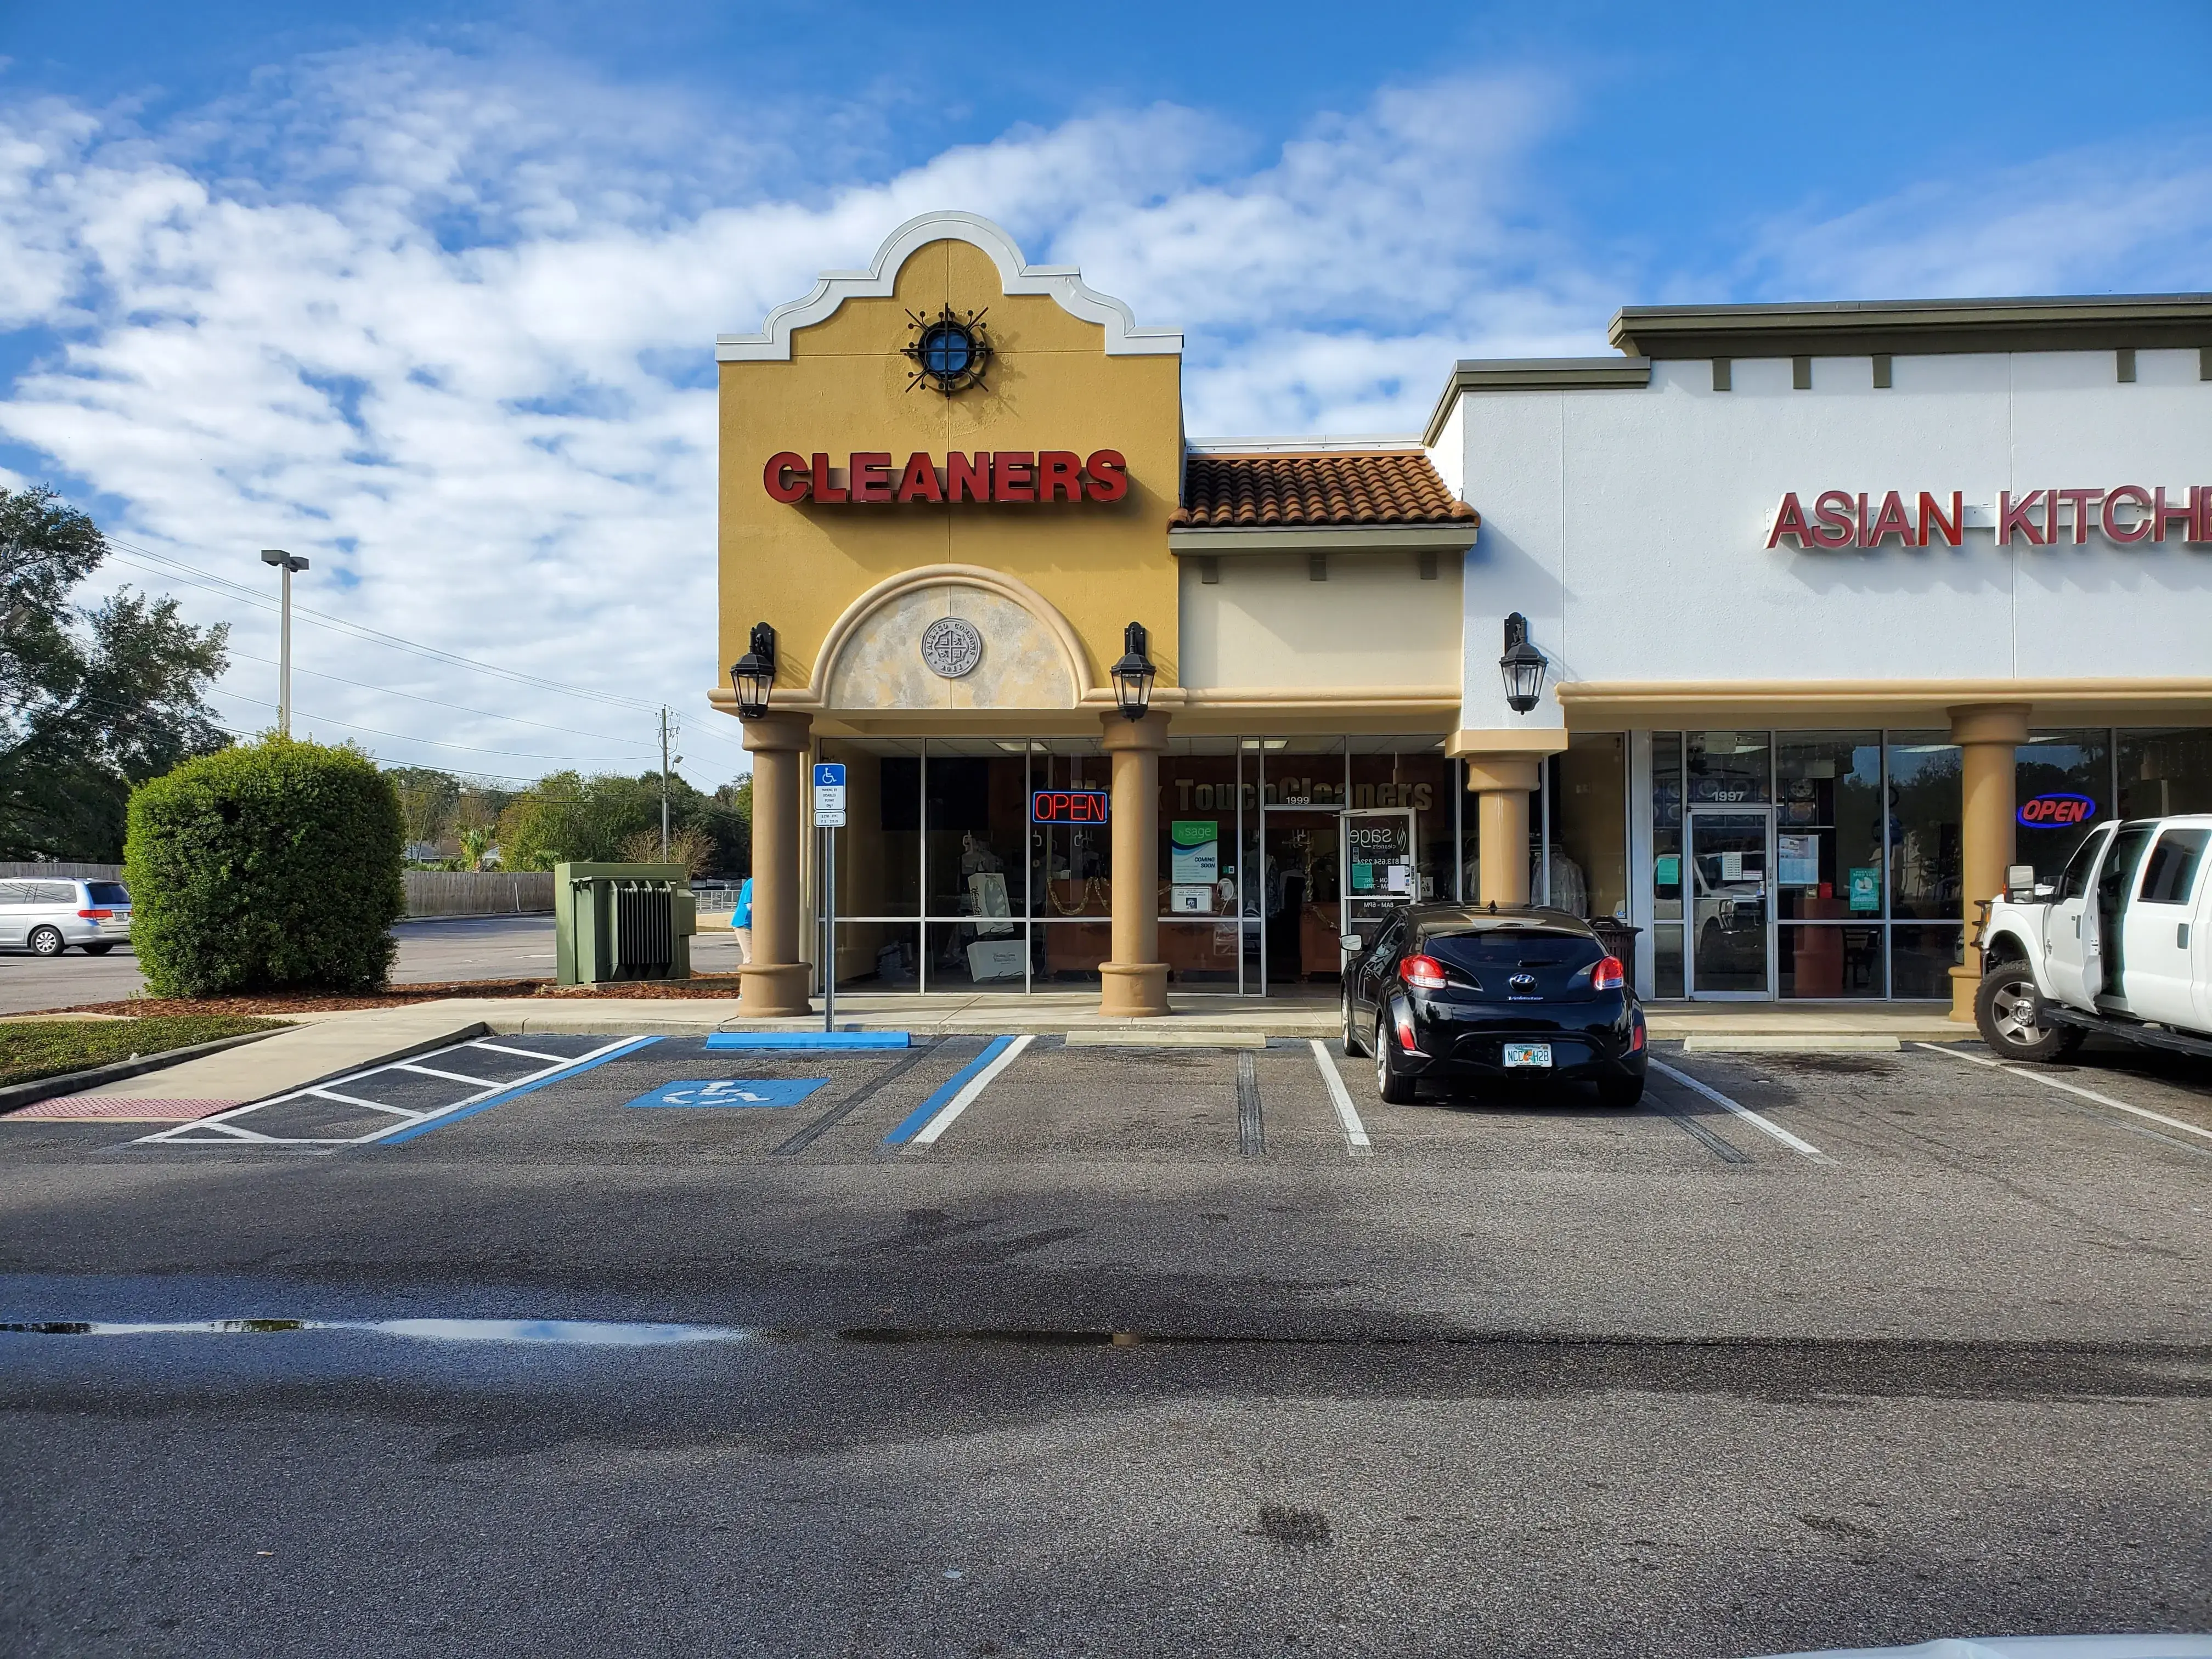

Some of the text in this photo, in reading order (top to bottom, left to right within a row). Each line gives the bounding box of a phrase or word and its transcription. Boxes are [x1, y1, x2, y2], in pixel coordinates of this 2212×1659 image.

[763, 449, 1128, 504] CLEANERS
[1765, 489, 1963, 549] ASIAN
[954, 623, 976, 656] COMMONS
[940, 663, 963, 672] 2011
[1286, 796, 1310, 804] 1999
[1712, 791, 1745, 802] 1997
[1035, 794, 1104, 821] OPEN
[2023, 800, 2087, 822] OPEN
[1185, 827, 1211, 838] sage
[1508, 1051, 1549, 1062] NCC H28
